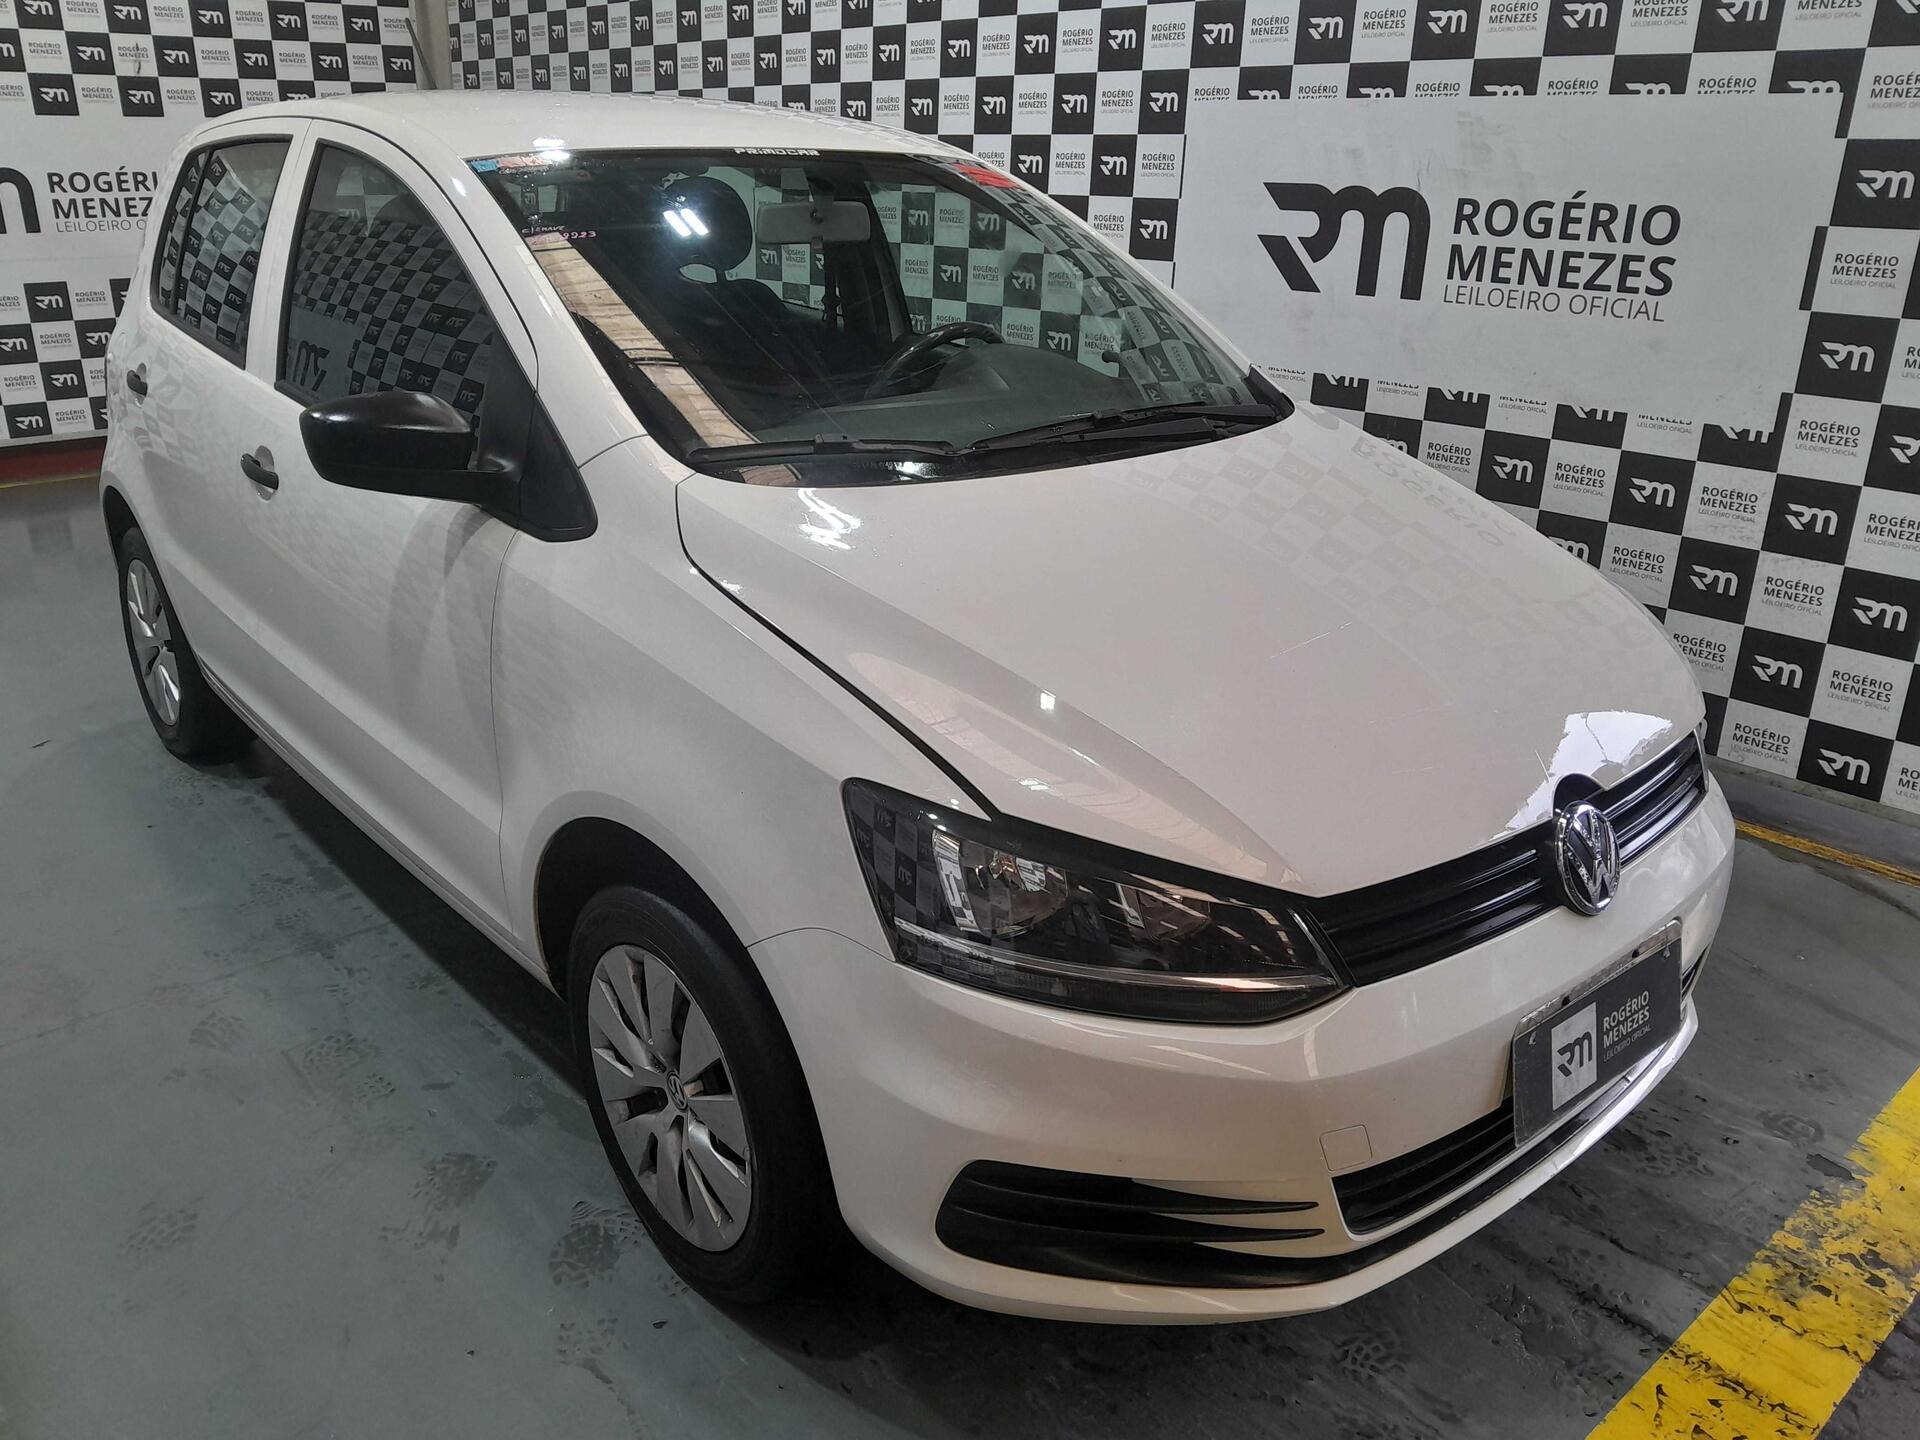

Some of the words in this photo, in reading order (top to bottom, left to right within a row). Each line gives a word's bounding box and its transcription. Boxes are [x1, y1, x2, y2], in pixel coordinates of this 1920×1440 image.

[1490, 1, 1538, 13] ROGÉRIO
[1632, 6, 1688, 18] MENEZES
[1363, 8, 1406, 20] ROGÉRIO
[1488, 13, 1538, 24] MENEZES
[1152, 22, 1185, 31] ROGÉRIO
[1251, 16, 1289, 26] ROGÉRIO
[1362, 20, 1406, 30] MENEZES
[1063, 28, 1093, 37] ROGÉRIO
[1151, 31, 1185, 41] MENEZES
[1251, 26, 1289, 36] MENEZES
[983, 33, 1010, 42] ROGÉRIO
[1062, 36, 1093, 46] MENEZES
[982, 41, 1010, 50] MENEZES
[1415, 81, 1460, 92] ROGÉRIO
[1548, 78, 1598, 90] ROGÉRIO
[1698, 77, 1756, 89] ROGÉRIO
[1873, 74, 1920, 87] ROGÉR
[1102, 89, 1133, 98] ROGÉRIO
[1195, 87, 1230, 96] ROGÉRIO
[1298, 84, 1338, 94] ROGÉRIO
[1870, 87, 1920, 98] MENEZ
[876, 96, 899, 104] ROGÉRIO
[944, 93, 969, 102] ROGÉRIO
[1019, 92, 1047, 100] ROGÉRIO
[876, 103, 899, 111] MENEZES
[944, 101, 969, 109] MENEZES
[1018, 100, 1047, 108] MENEZES
[1102, 98, 1133, 107] MENEZES
[1056, 152, 1085, 161] ROGÉRIO
[1142, 152, 1175, 161] ROGÉRIO
[1056, 161, 1085, 169] MENEZES
[1142, 162, 1174, 170] MENEZES
[47, 166, 158, 193] ROGÉRI
[52, 197, 153, 219] MENEZ
[1094, 214, 1124, 223] ROGÉRIO
[1453, 191, 1681, 246] ROGÉRIO
[56, 220, 131, 232] LEILOEIRO
[1094, 223, 1124, 232] MENEZES
[1835, 252, 1899, 266] ROGÉRIO
[1447, 244, 1677, 297] MENEZES
[1832, 265, 1897, 279] MENEZES
[1443, 284, 1561, 313] LEILOEIRO
[1569, 294, 1665, 322] OFICIAL
[1800, 420, 1860, 436] ROGÉRIO
[1798, 431, 1858, 448] MENEZES
[1428, 442, 1472, 456] ROGÉRIO
[1427, 451, 1470, 466] MENEZES
[1556, 462, 1605, 478] ROGÉRIO
[1554, 472, 1604, 488] MENEZES
[1701, 486, 1758, 503] ROGÉRIO
[1700, 496, 1757, 514] MENEZES
[1868, 514, 1920, 530] ROGÉRI
[1866, 525, 1920, 543] MENEZE
[1614, 547, 1665, 563] ROGÉRIO
[1612, 556, 1664, 574] MENEZES
[1766, 576, 1824, 595] ROGÉRIO
[1764, 587, 1823, 606] MENEZES
[1673, 633, 1726, 652] ROGÉRIO
[1832, 670, 1893, 692] ROGÉRIO
[1830, 681, 1891, 703] MENEZES
[1734, 723, 1790, 744] ROGÉRIO
[1732, 732, 1789, 755] MENEZES
[1603, 991, 1649, 1031] ROGÉRIO
[1603, 1008, 1650, 1049] MENEZES
